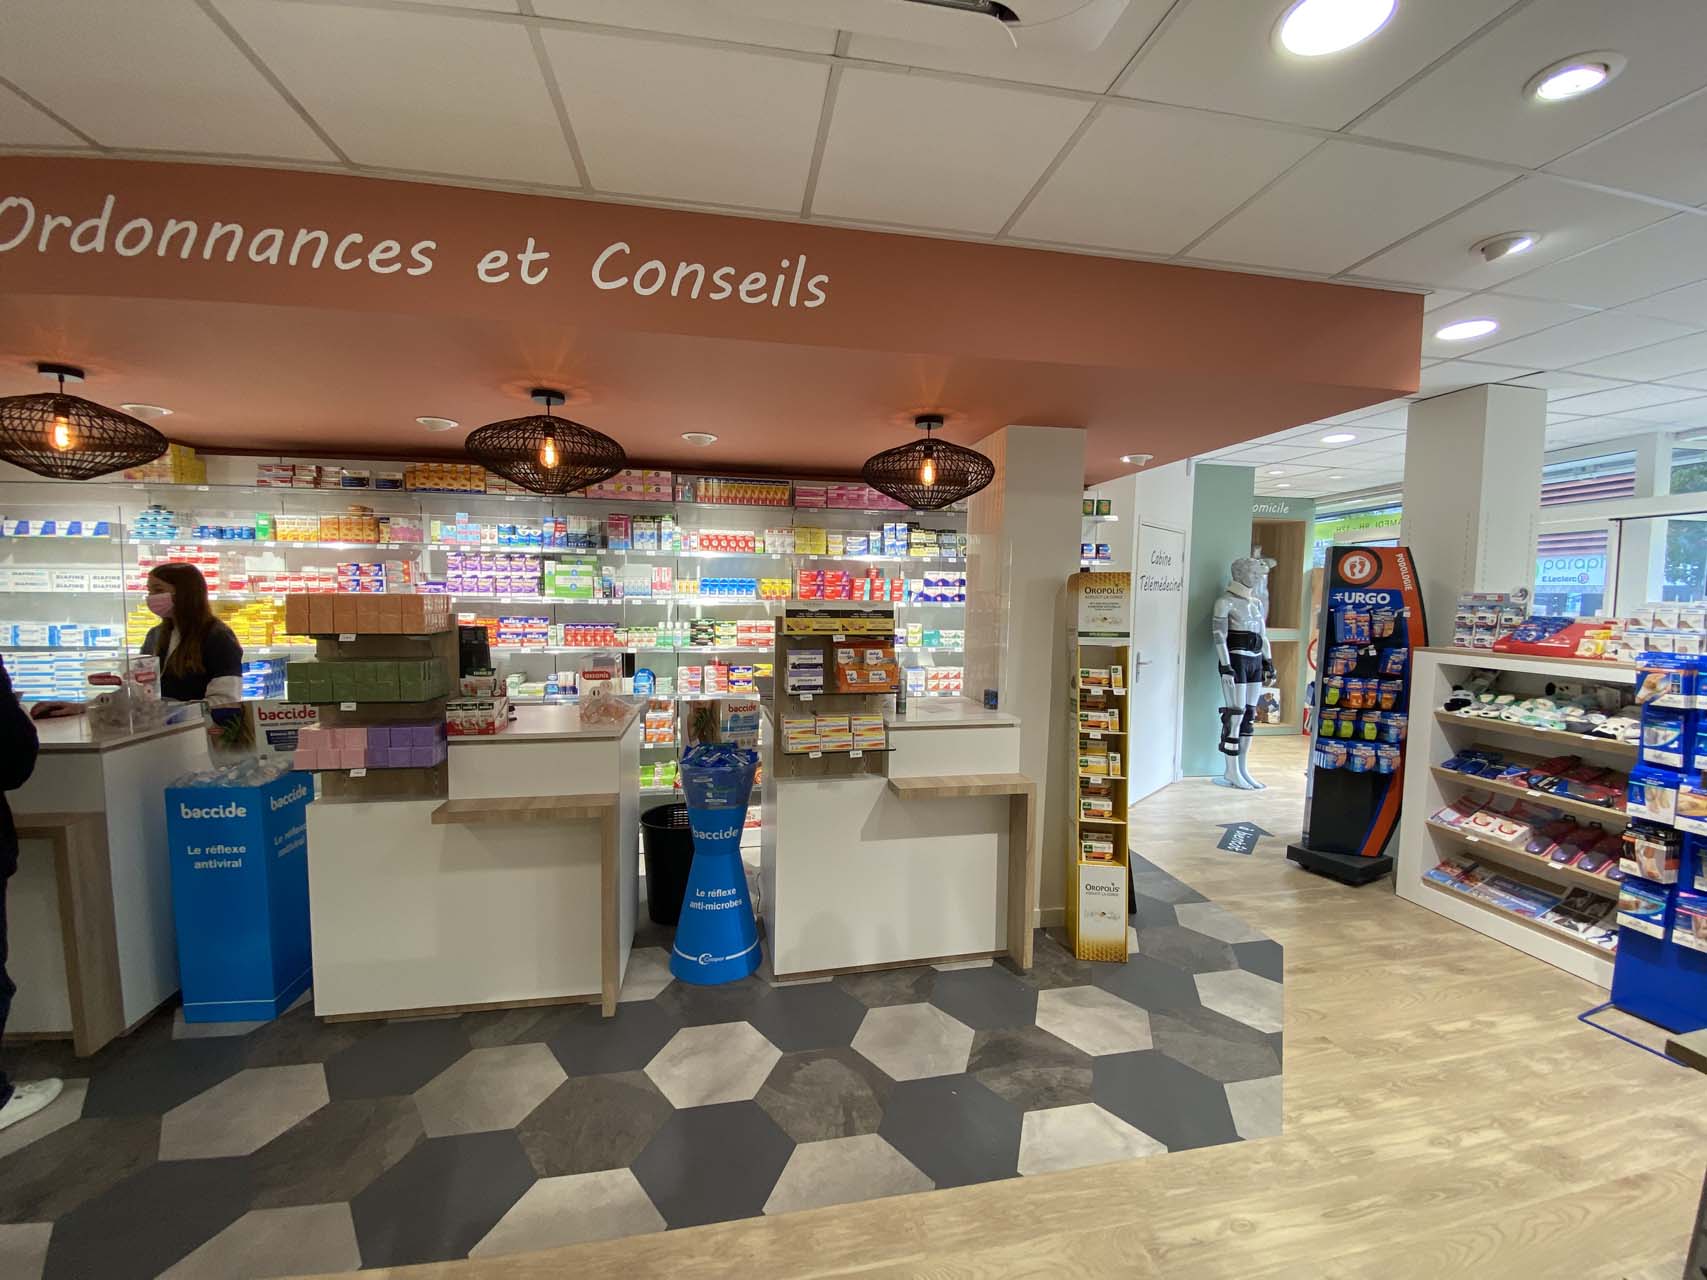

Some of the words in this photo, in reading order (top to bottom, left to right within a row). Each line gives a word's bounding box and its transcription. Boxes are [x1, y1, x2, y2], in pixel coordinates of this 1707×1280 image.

[0, 194, 437, 276] Ordonnances
[476, 237, 550, 285] et
[591, 241, 829, 308] Conseils
[1252, 501, 1289, 514] omicile
[1150, 549, 1172, 566] Cabine
[1396, 553, 1413, 591] PODOLOGIE
[1084, 585, 1124, 595] OROPOLIS
[1344, 592, 1391, 604] URGO
[257, 704, 317, 720] baccide
[728, 703, 756, 713] baccide
[270, 784, 307, 811] baccide
[180, 802, 247, 819] baccide
[692, 825, 739, 840] baccide
[187, 845, 201, 855] Le
[205, 844, 247, 854] réflexe
[193, 858, 242, 868] antiviral
[696, 888, 706, 897] Le
[708, 888, 737, 898] réflexe
[1085, 883, 1121, 893] OROPOLIS
[689, 899, 743, 911] anti-microbes
